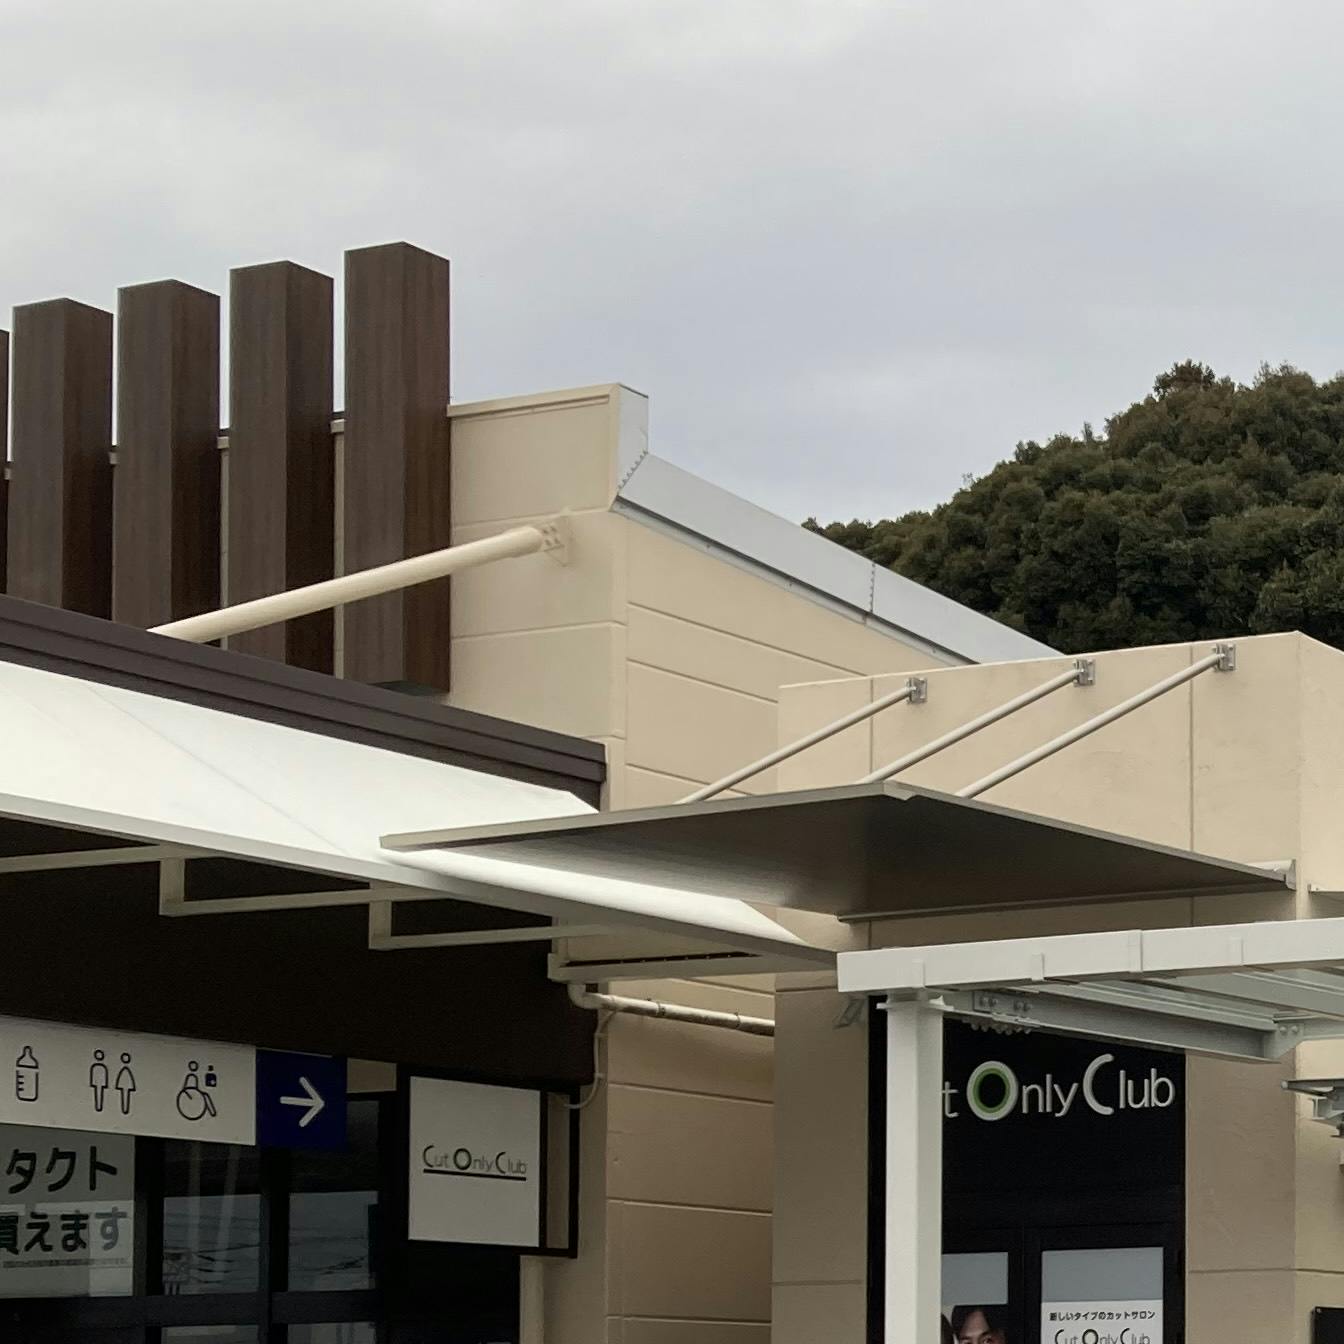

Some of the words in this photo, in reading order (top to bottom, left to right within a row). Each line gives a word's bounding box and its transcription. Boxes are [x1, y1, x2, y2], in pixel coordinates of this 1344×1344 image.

[966, 1060, 1079, 1121] Only
[1083, 1053, 1176, 1115] Club
[423, 1145, 449, 1168] Cut
[453, 1148, 493, 1172] Only
[495, 1151, 527, 1174] Club
